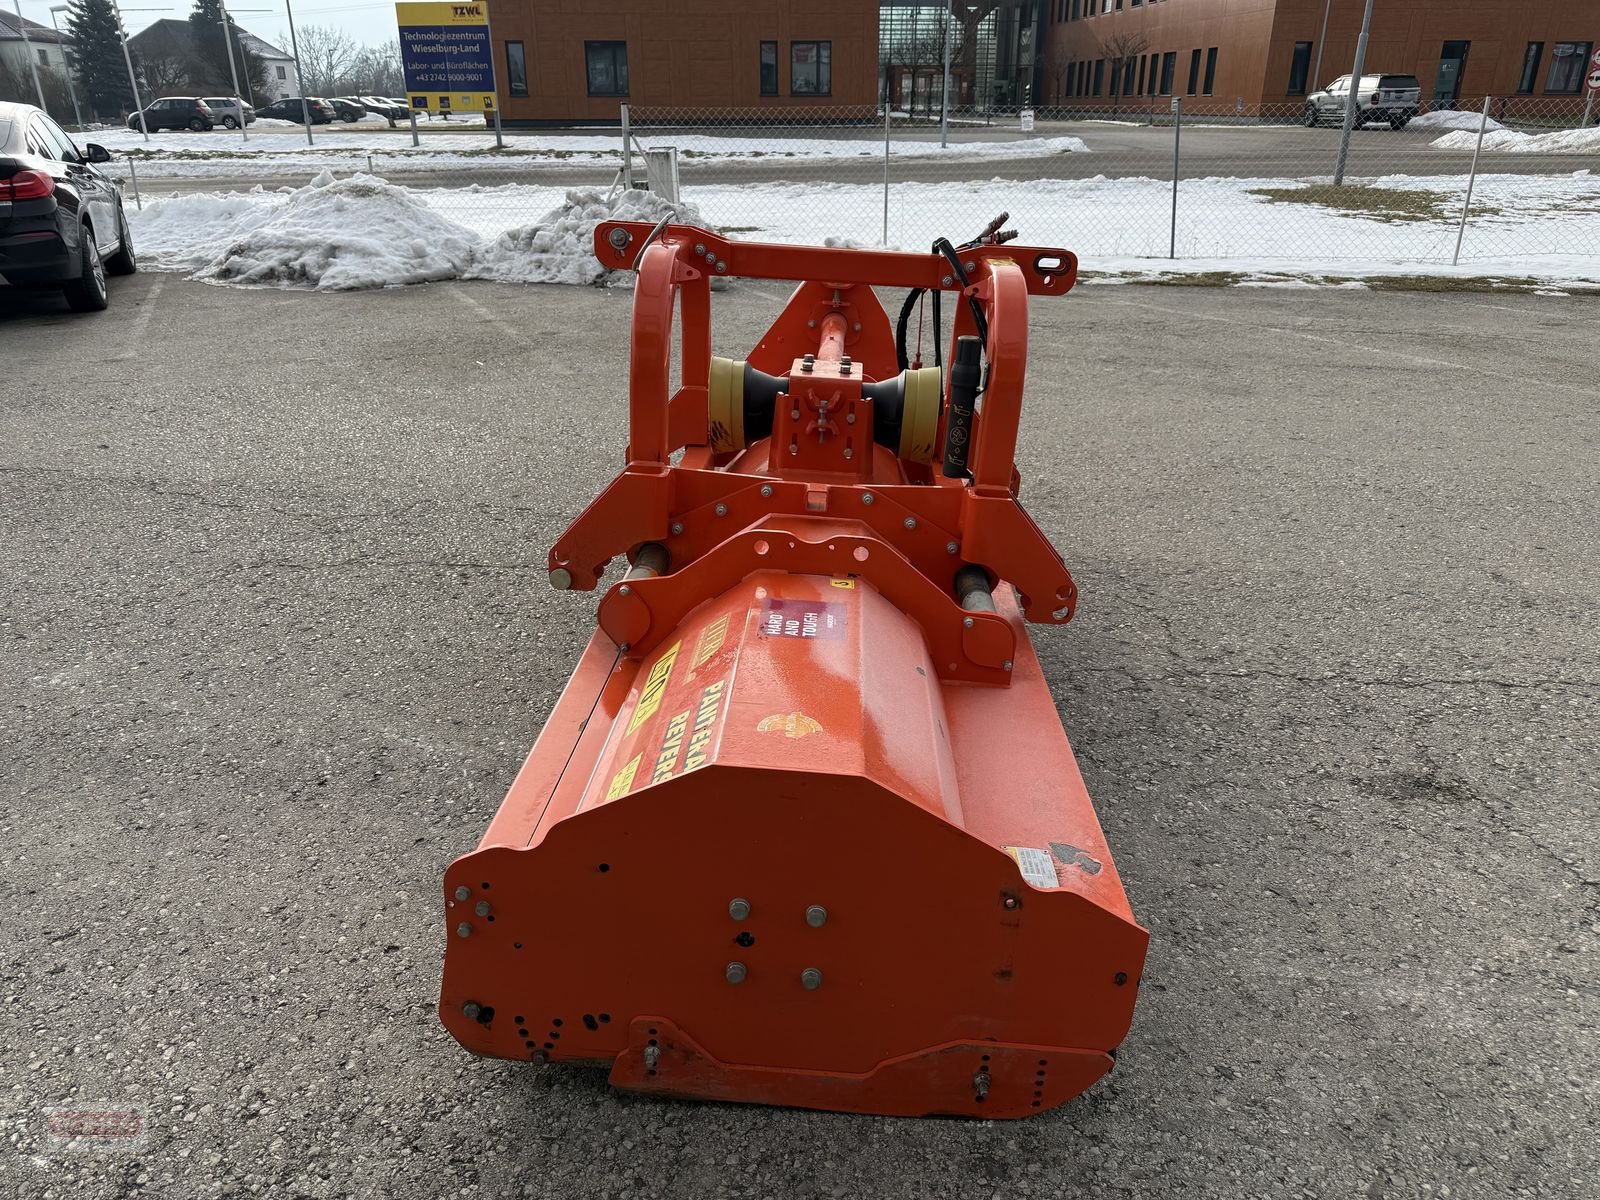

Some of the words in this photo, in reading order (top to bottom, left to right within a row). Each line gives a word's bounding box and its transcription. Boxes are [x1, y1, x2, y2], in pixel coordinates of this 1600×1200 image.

[453, 6, 481, 15] TZWL
[403, 32, 486, 42] Technologiezentrum
[411, 44, 480, 54] Wieselburg-Land
[408, 62, 430, 70] Labor-
[431, 62, 445, 70] und
[446, 61, 489, 70] Büroflächen
[416, 73, 429, 81] +43
[767, 614, 783, 635] HARD
[784, 620, 800, 636] AND
[802, 612, 818, 637] TOUGH
[684, 680, 725, 772] PANTERA
